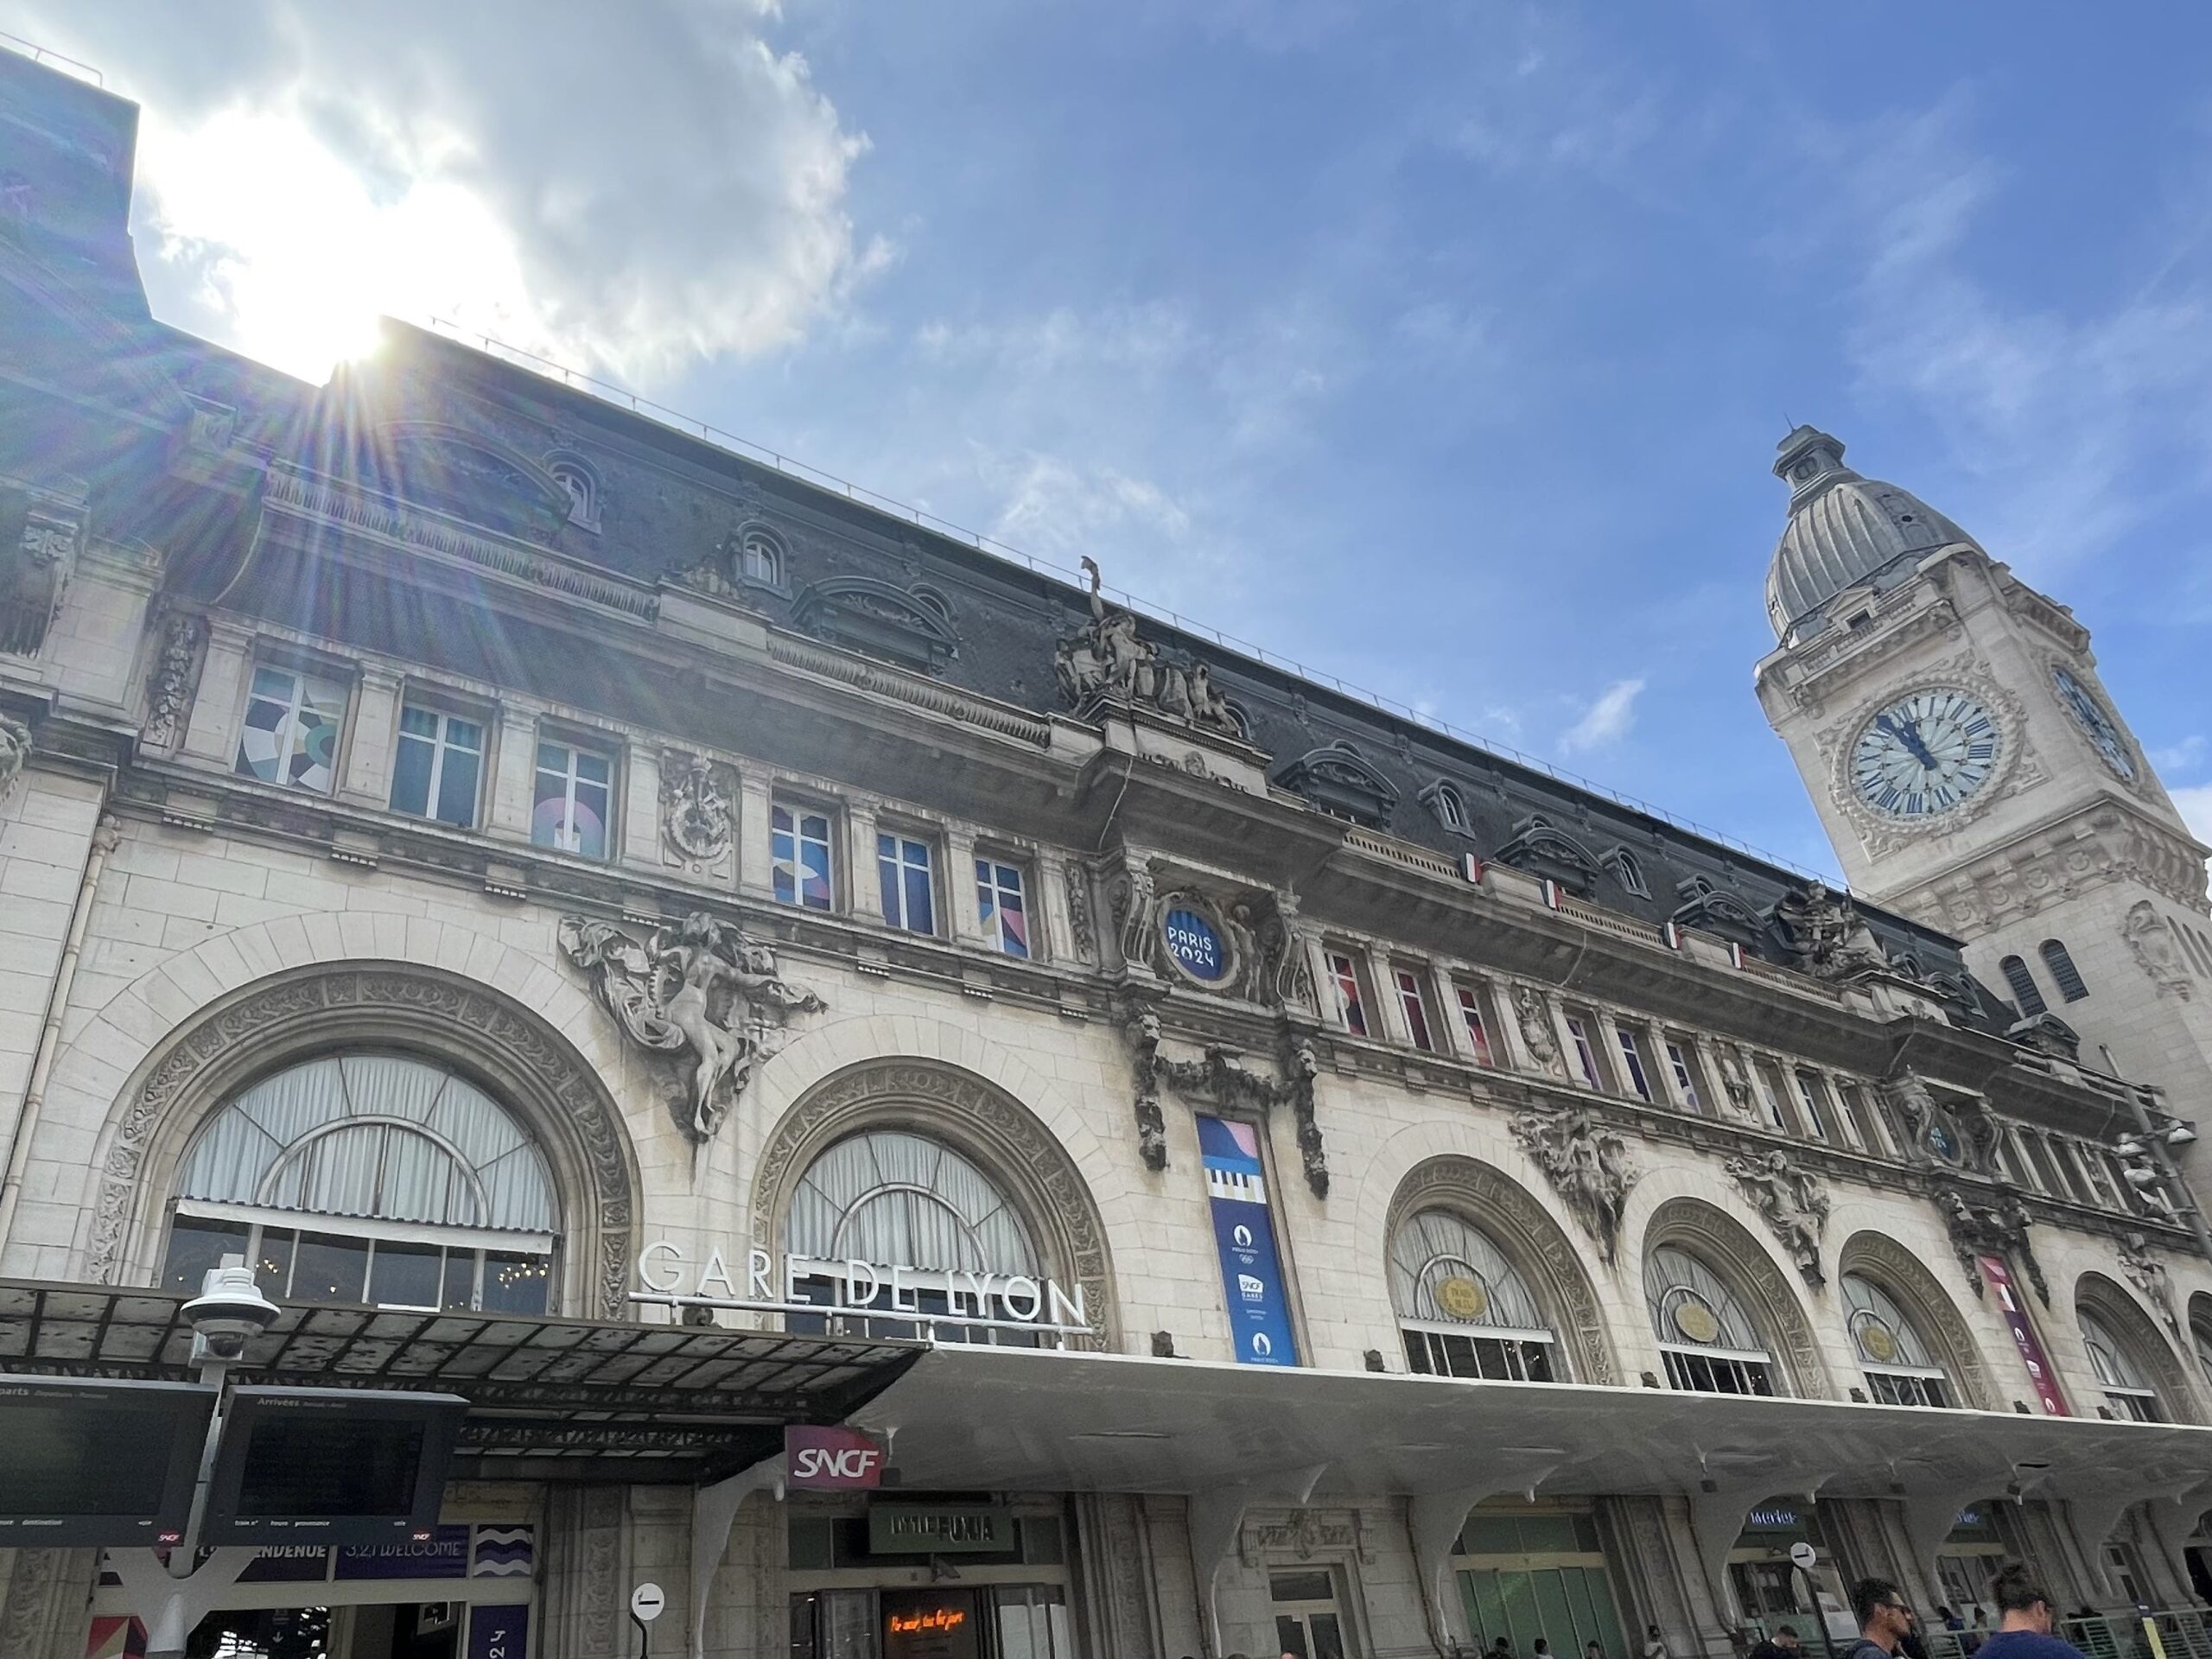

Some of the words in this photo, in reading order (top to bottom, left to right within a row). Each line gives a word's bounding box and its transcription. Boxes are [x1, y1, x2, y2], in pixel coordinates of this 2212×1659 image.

[1167, 926, 1212, 950] PARIS
[1170, 942, 1214, 967] 2024
[638, 1241, 811, 1302] GARE
[847, 1258, 916, 1312] DE
[947, 1268, 1086, 1327] LYON
[1242, 1281, 1261, 1290] SNCF
[794, 1449, 880, 1478] SNCF
